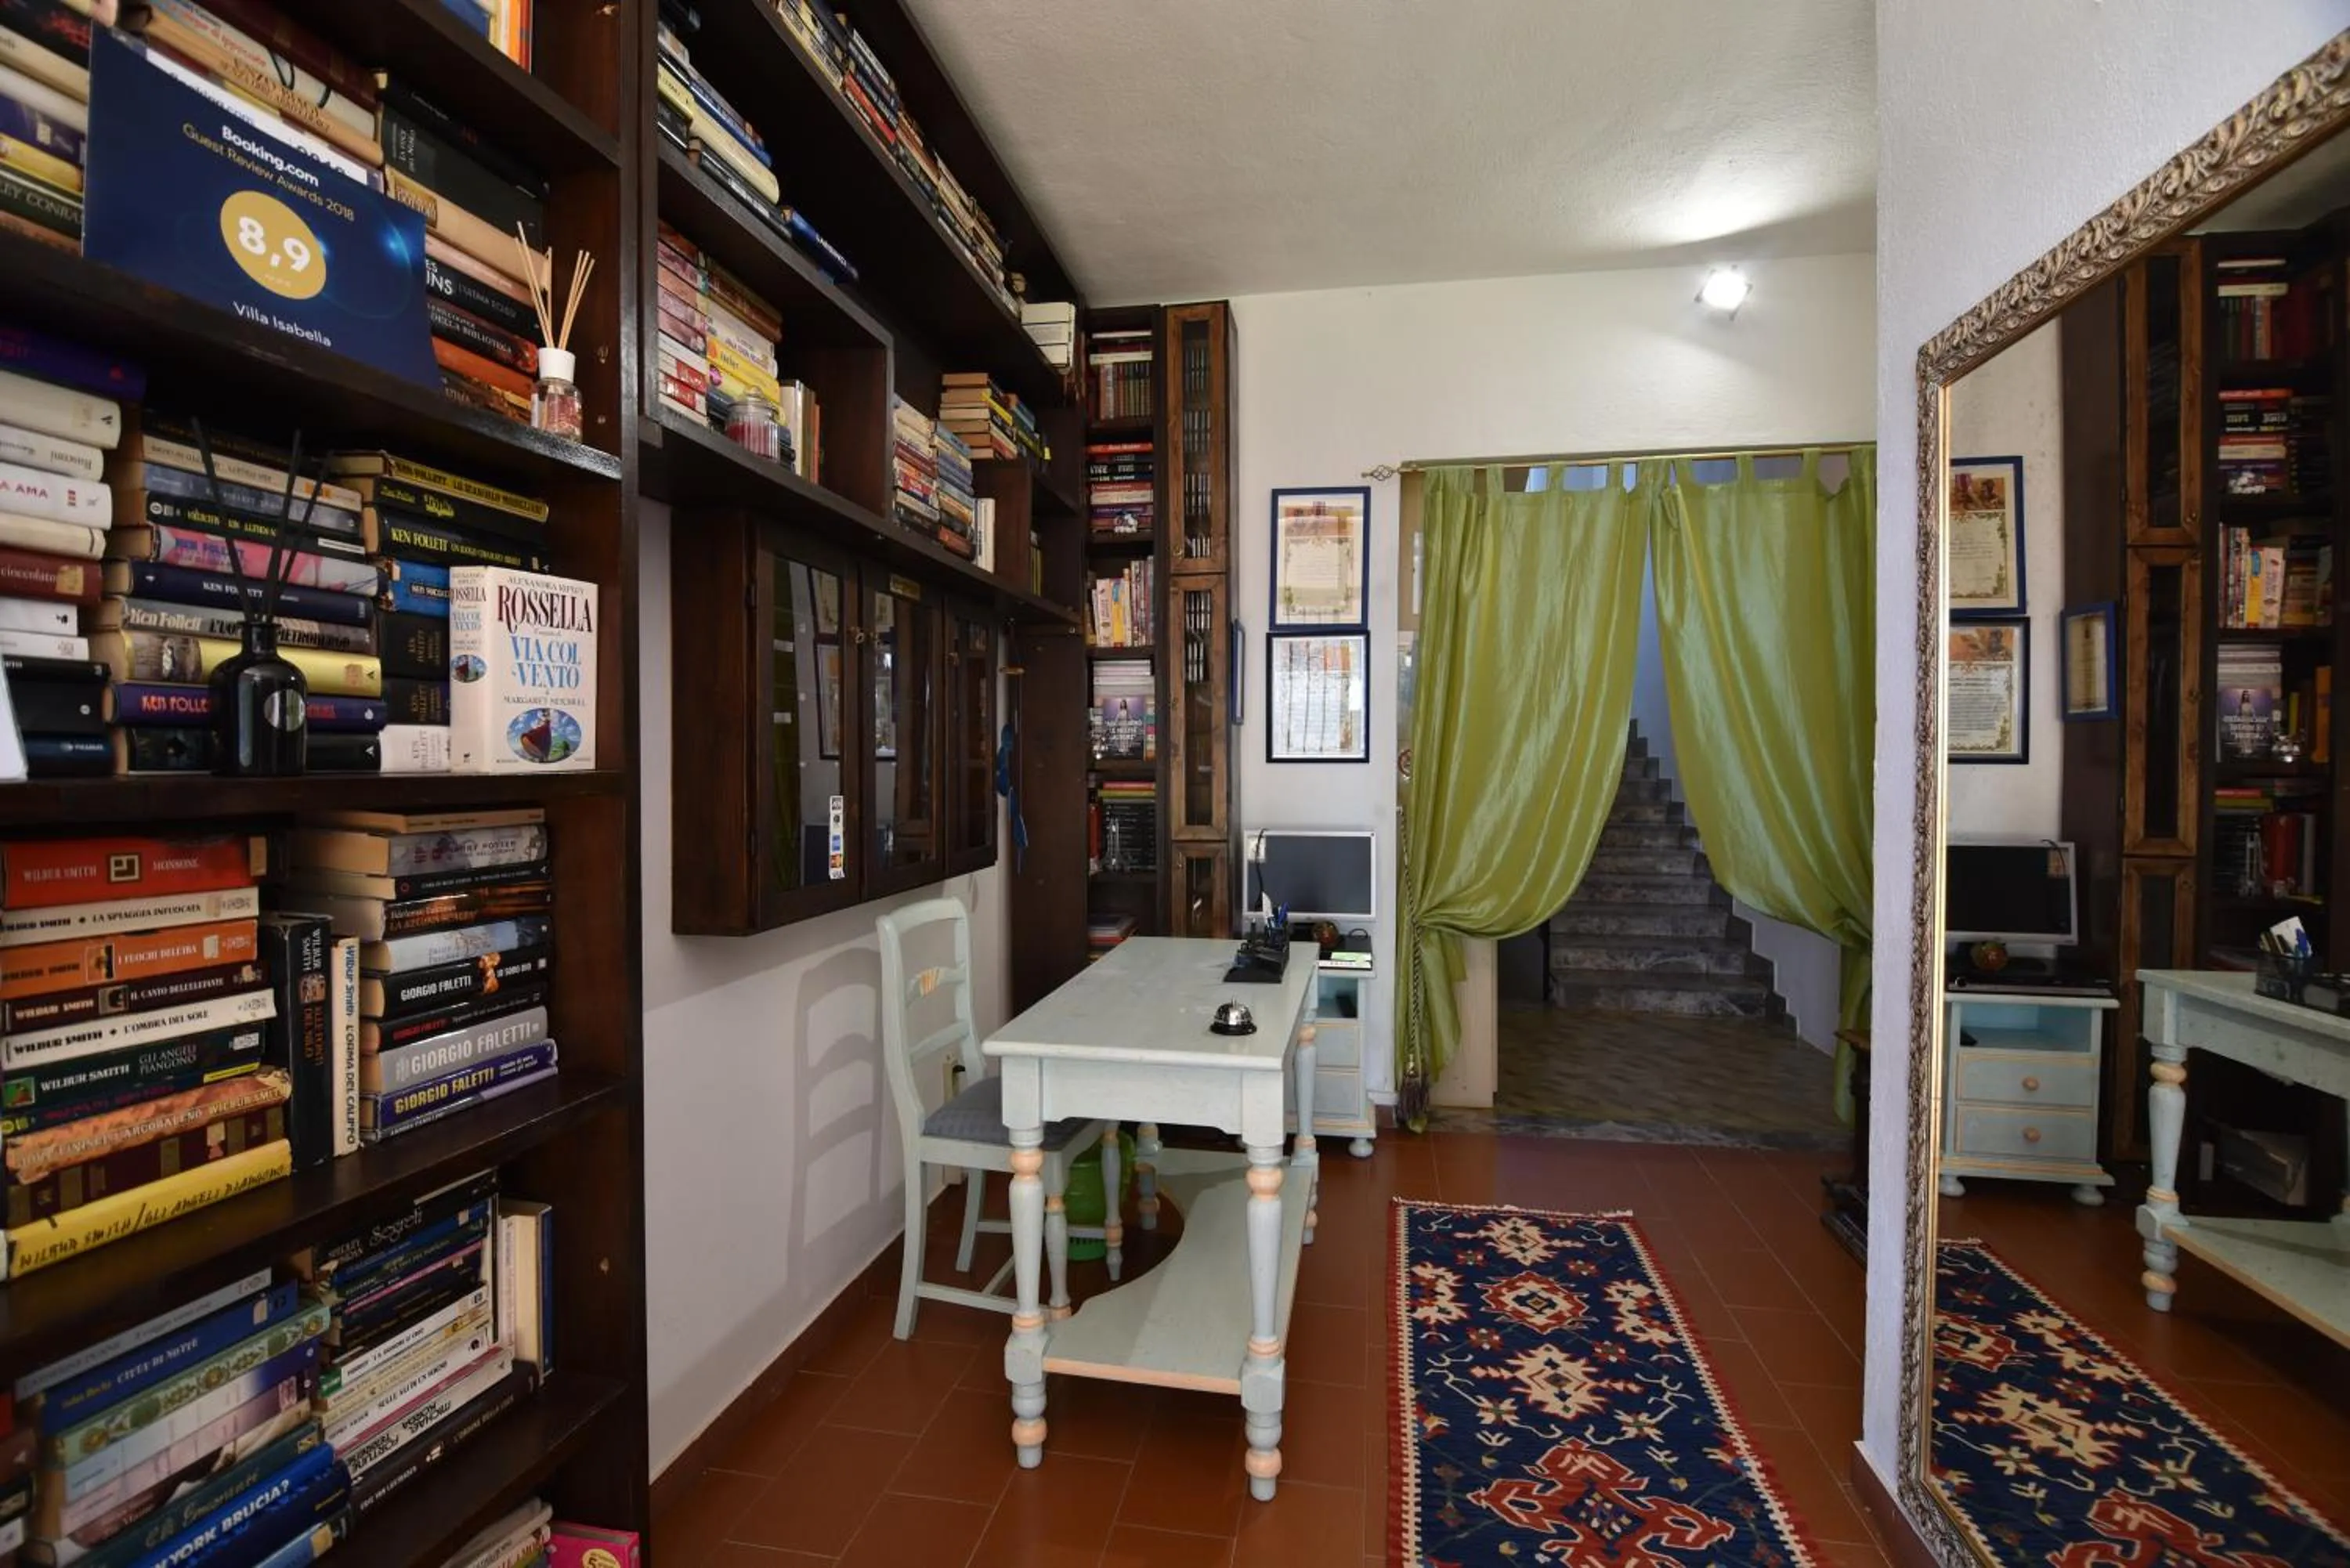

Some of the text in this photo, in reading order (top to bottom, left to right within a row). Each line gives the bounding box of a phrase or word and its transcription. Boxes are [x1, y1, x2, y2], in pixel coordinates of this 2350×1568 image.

[183, 122, 224, 155] Guest
[227, 148, 273, 181] Review
[277, 175, 324, 206] Awards
[326, 198, 355, 222] 2018
[222, 125, 319, 186] Booking.com
[238, 216, 311, 273] 8,9
[233, 301, 331, 347] Villa Isabella
[392, 528, 410, 543] KEN
[413, 533, 447, 551] FOLLETT
[203, 581, 222, 592] KEN
[508, 576, 557, 591] ALEXANDRA
[130, 608, 157, 626] Ken
[157, 611, 202, 631] Follett
[497, 586, 592, 634] ROSSELLA
[512, 635, 581, 665] VIA COL
[516, 662, 580, 690] VENTO
[141, 695, 167, 712] KEN
[345, 945, 355, 981] Wilbur
[400, 984, 437, 1002] GIORGIO
[438, 976, 472, 992] FALETTI
[13, 1036, 63, 1055] WILBUR
[65, 1028, 103, 1046] SMITH
[410, 1021, 531, 1075] GIORGIO FALETTI
[41, 1043, 197, 1093] WILBUR SMITH GLI ANGELI
[139, 1054, 197, 1076] PIANGONO
[395, 1067, 494, 1115] GIORGIO FALETTI
[83, 1218, 132, 1246] SMITH
[171, 1187, 220, 1213] ANGELI
[167, 1525, 217, 1564] YORK
[221, 1479, 291, 1532] BRUCIA?
